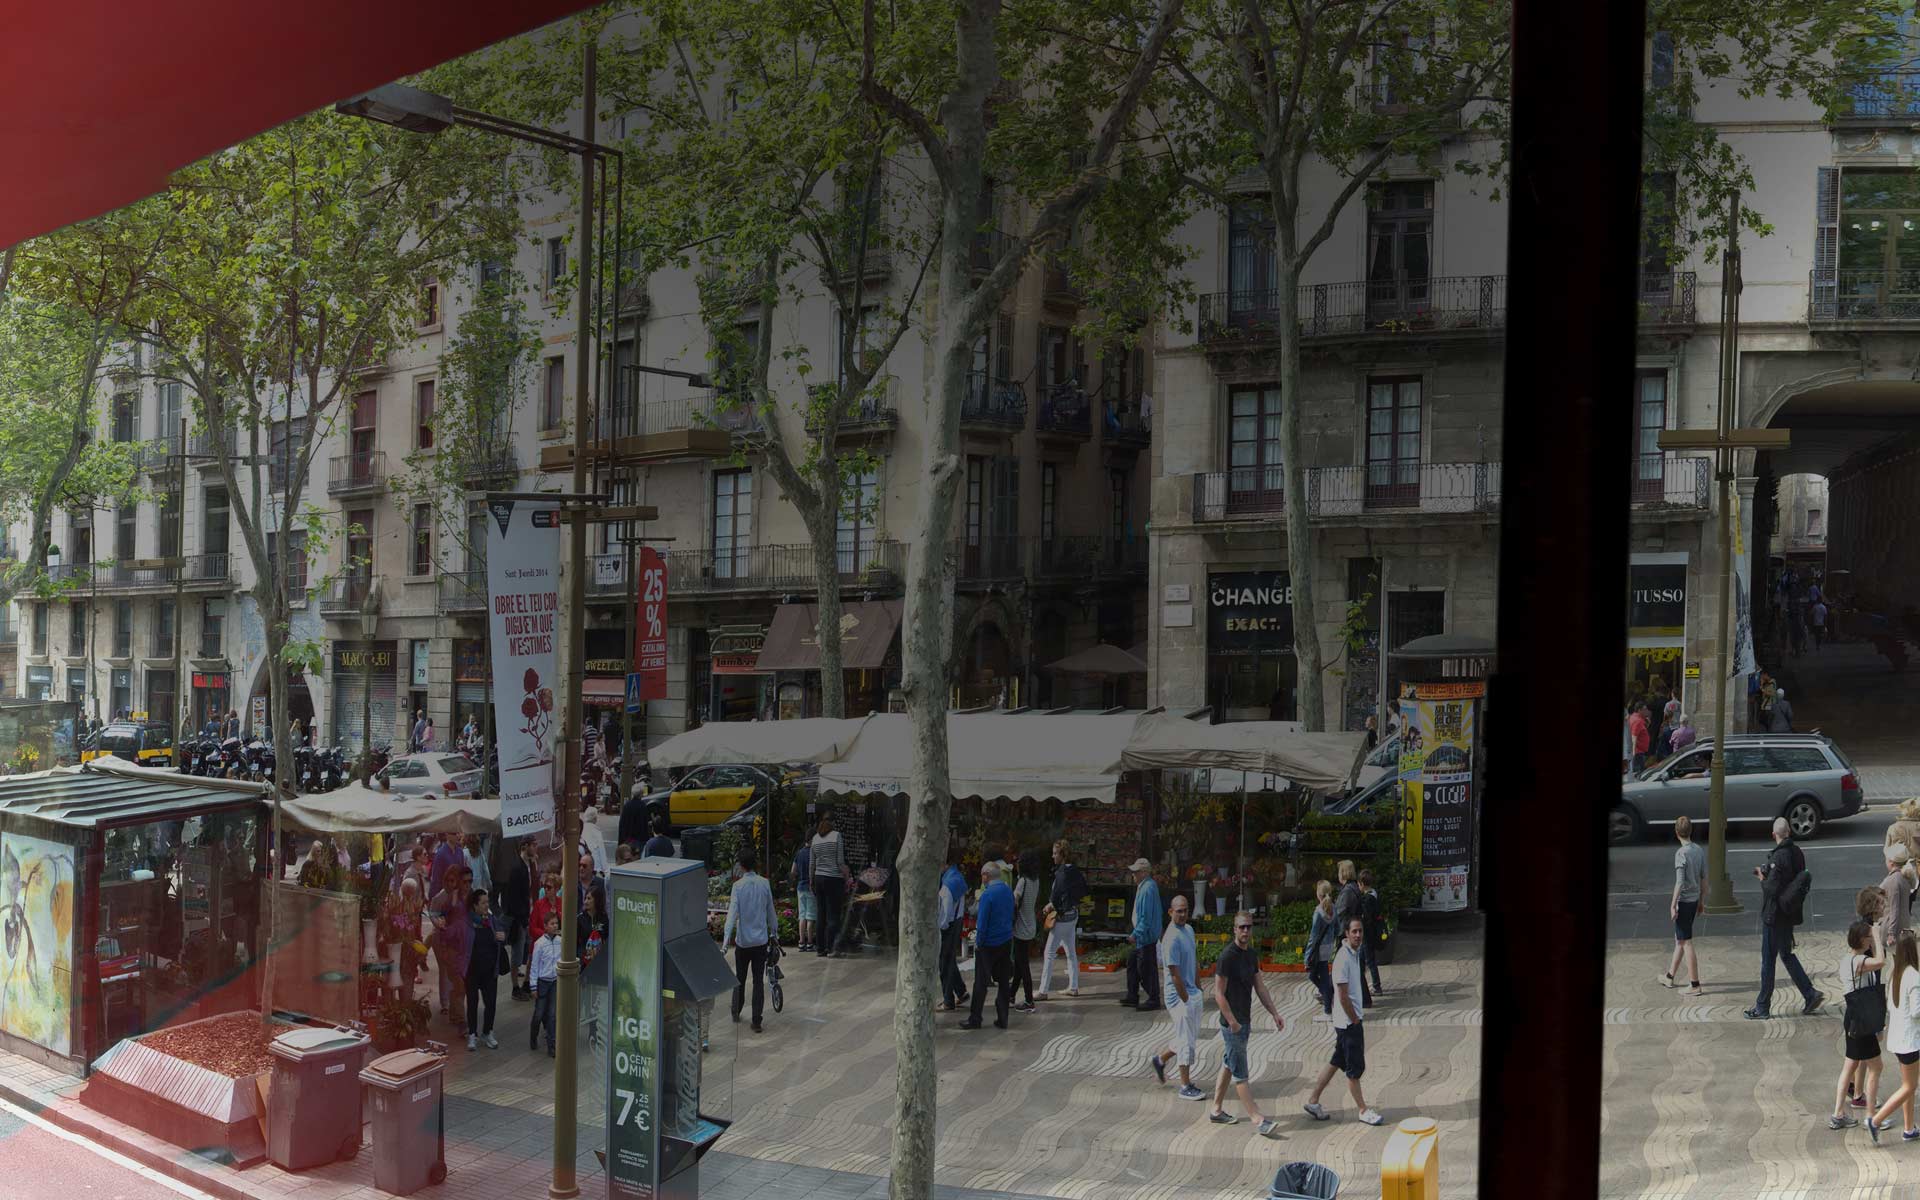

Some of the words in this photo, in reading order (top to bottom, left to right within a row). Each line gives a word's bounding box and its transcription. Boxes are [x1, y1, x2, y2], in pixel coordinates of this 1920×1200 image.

[644, 568, 664, 602] 25
[495, 595, 515, 615] OBRE
[516, 594, 529, 613] EL
[529, 592, 543, 613] TEU
[1212, 586, 1293, 606] CHANGE
[540, 613, 554, 633] QUE
[418, 669, 426, 677] 79
[627, 898, 657, 914] tuenti
[617, 1016, 651, 1041] 1GB
[629, 1064, 650, 1080] MIN
